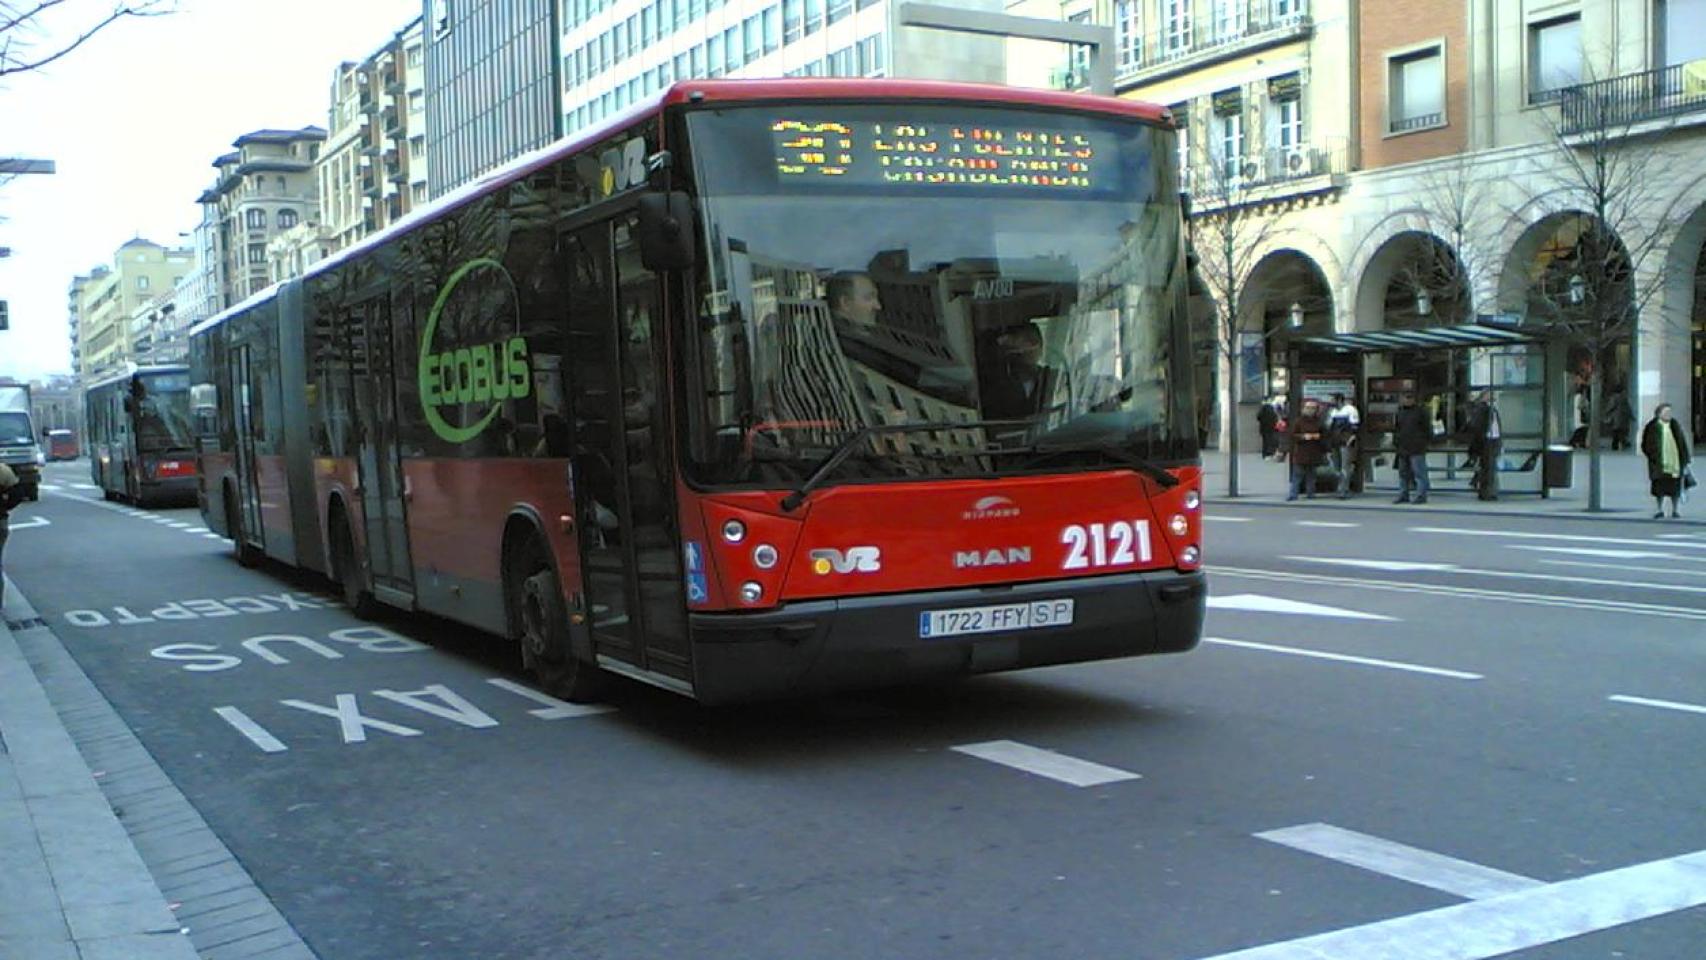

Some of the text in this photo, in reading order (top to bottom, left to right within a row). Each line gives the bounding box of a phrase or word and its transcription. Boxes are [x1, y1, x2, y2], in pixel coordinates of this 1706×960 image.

[421, 337, 530, 407] ECOBUS
[956, 546, 1032, 568] MAN
[1062, 519, 1153, 570] 2121
[939, 611, 983, 633] 1722
[991, 607, 1025, 628] FFY
[150, 626, 433, 671] BUS
[213, 678, 618, 753] TAXI
